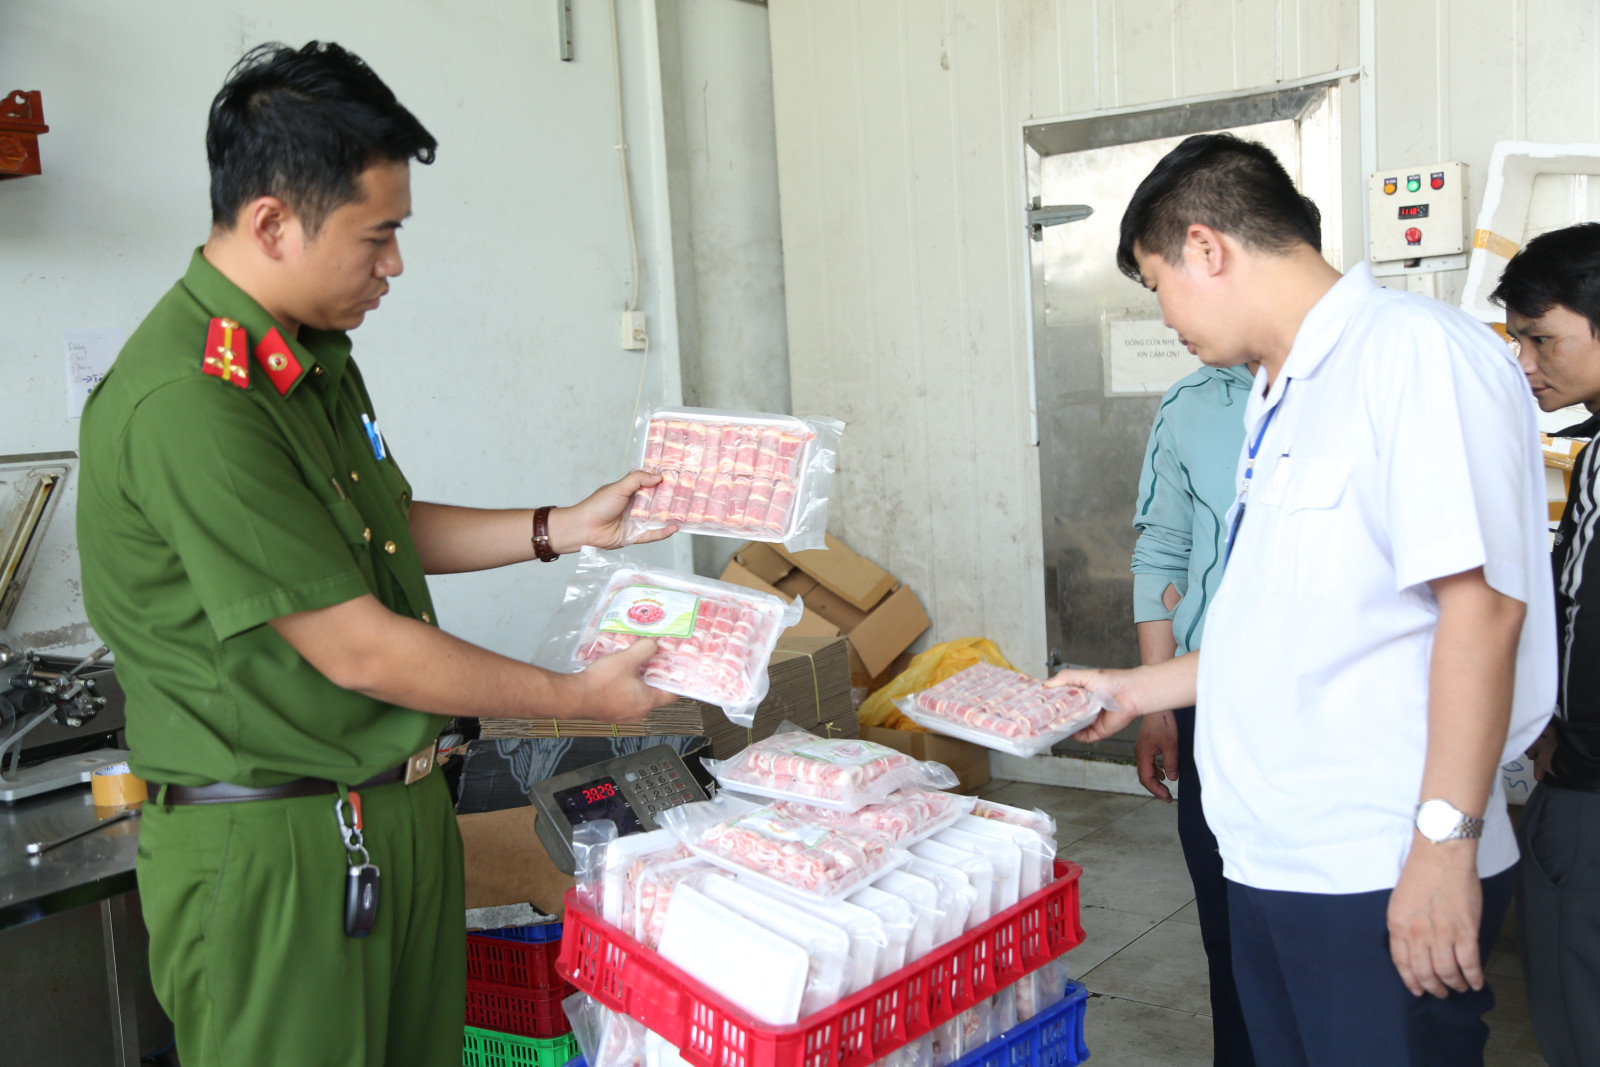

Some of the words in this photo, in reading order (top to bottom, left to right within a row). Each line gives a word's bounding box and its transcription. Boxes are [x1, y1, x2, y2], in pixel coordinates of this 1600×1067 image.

[635, 783, 642, 791] 4
[646, 779, 653, 787] 5
[658, 775, 666, 783] 6
[653, 790, 661, 798] 2
[648, 804, 656, 812] 0
